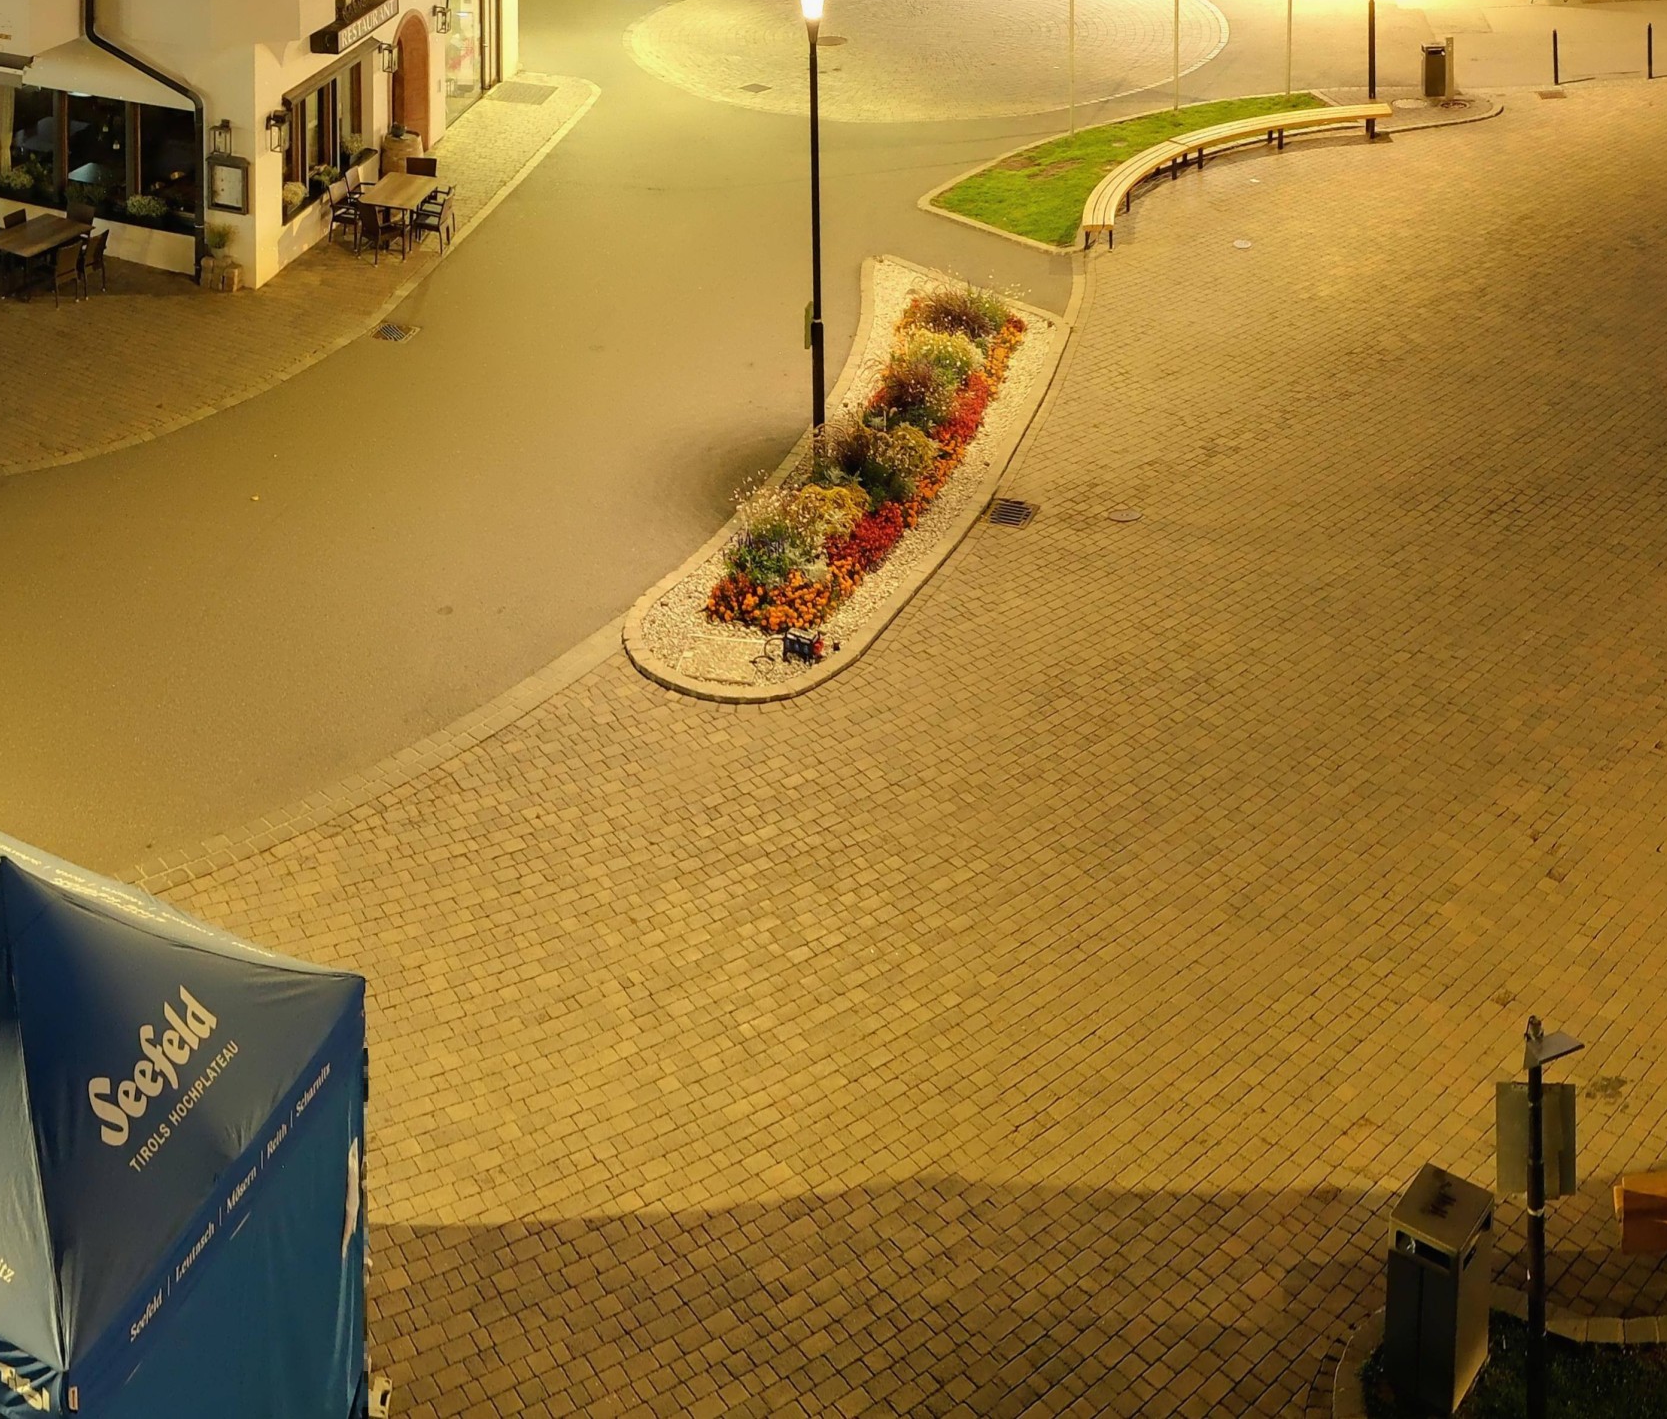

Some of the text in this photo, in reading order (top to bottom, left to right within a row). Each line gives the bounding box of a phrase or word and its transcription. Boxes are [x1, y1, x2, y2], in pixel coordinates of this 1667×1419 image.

[341, 0, 396, 47] RESTAURANT
[88, 984, 217, 1147] Seefeld
[129, 1039, 240, 1173] TIROLS HOCHPLATEAU
[130, 1288, 164, 1343] Seefeld
[174, 1221, 216, 1284] Leutasch
[266, 1124, 289, 1161] Reith
[294, 1061, 331, 1118] Scharnitz
